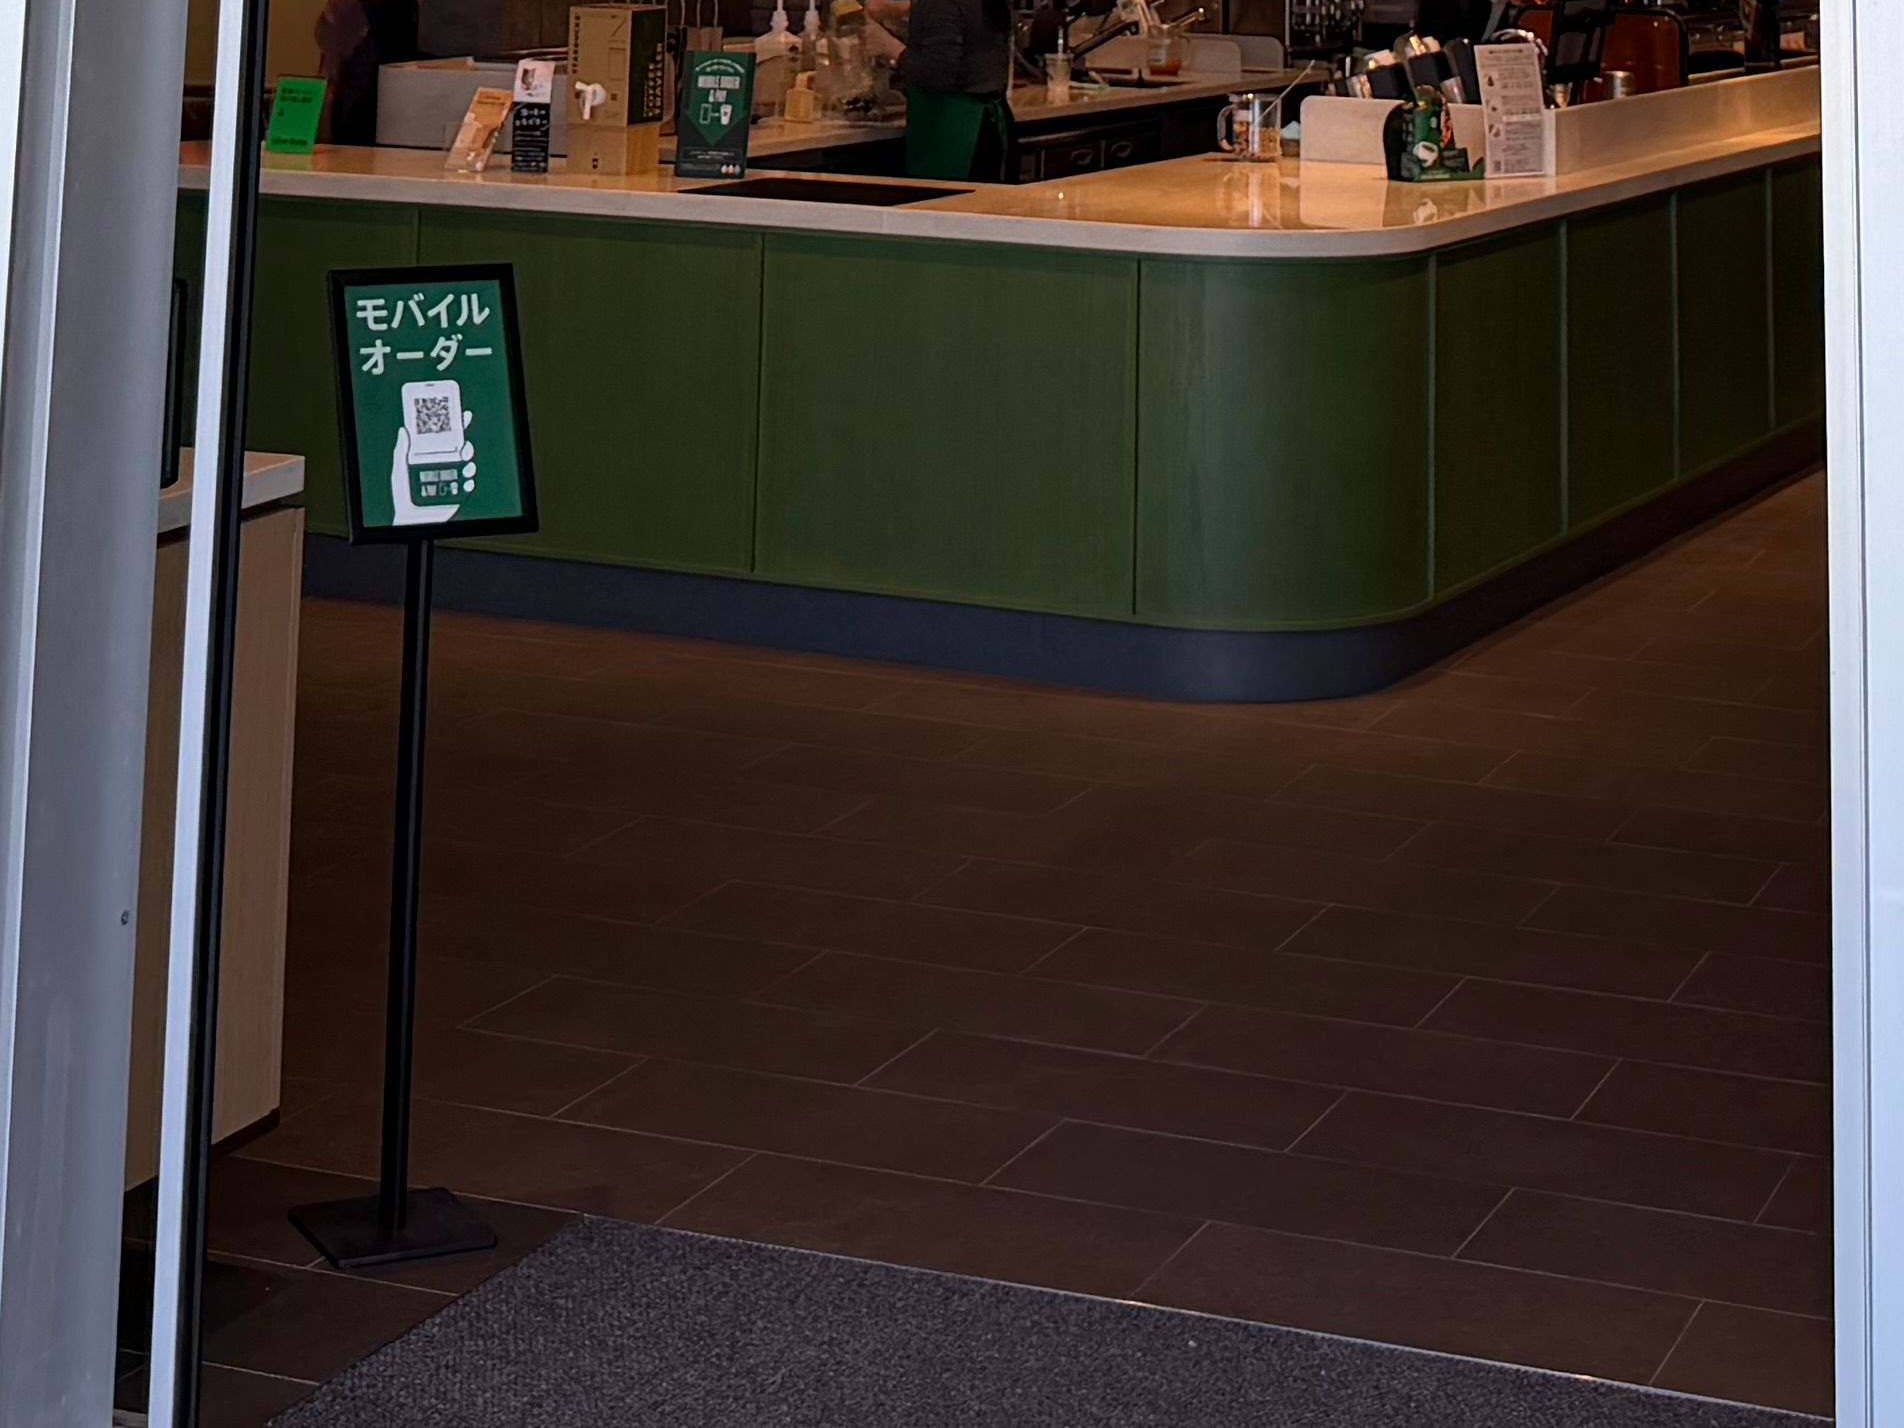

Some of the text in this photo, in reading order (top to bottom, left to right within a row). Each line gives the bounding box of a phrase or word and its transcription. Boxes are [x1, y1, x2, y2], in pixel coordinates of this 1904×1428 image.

[356, 291, 491, 332] モバイル
[359, 333, 493, 376] オーダー
